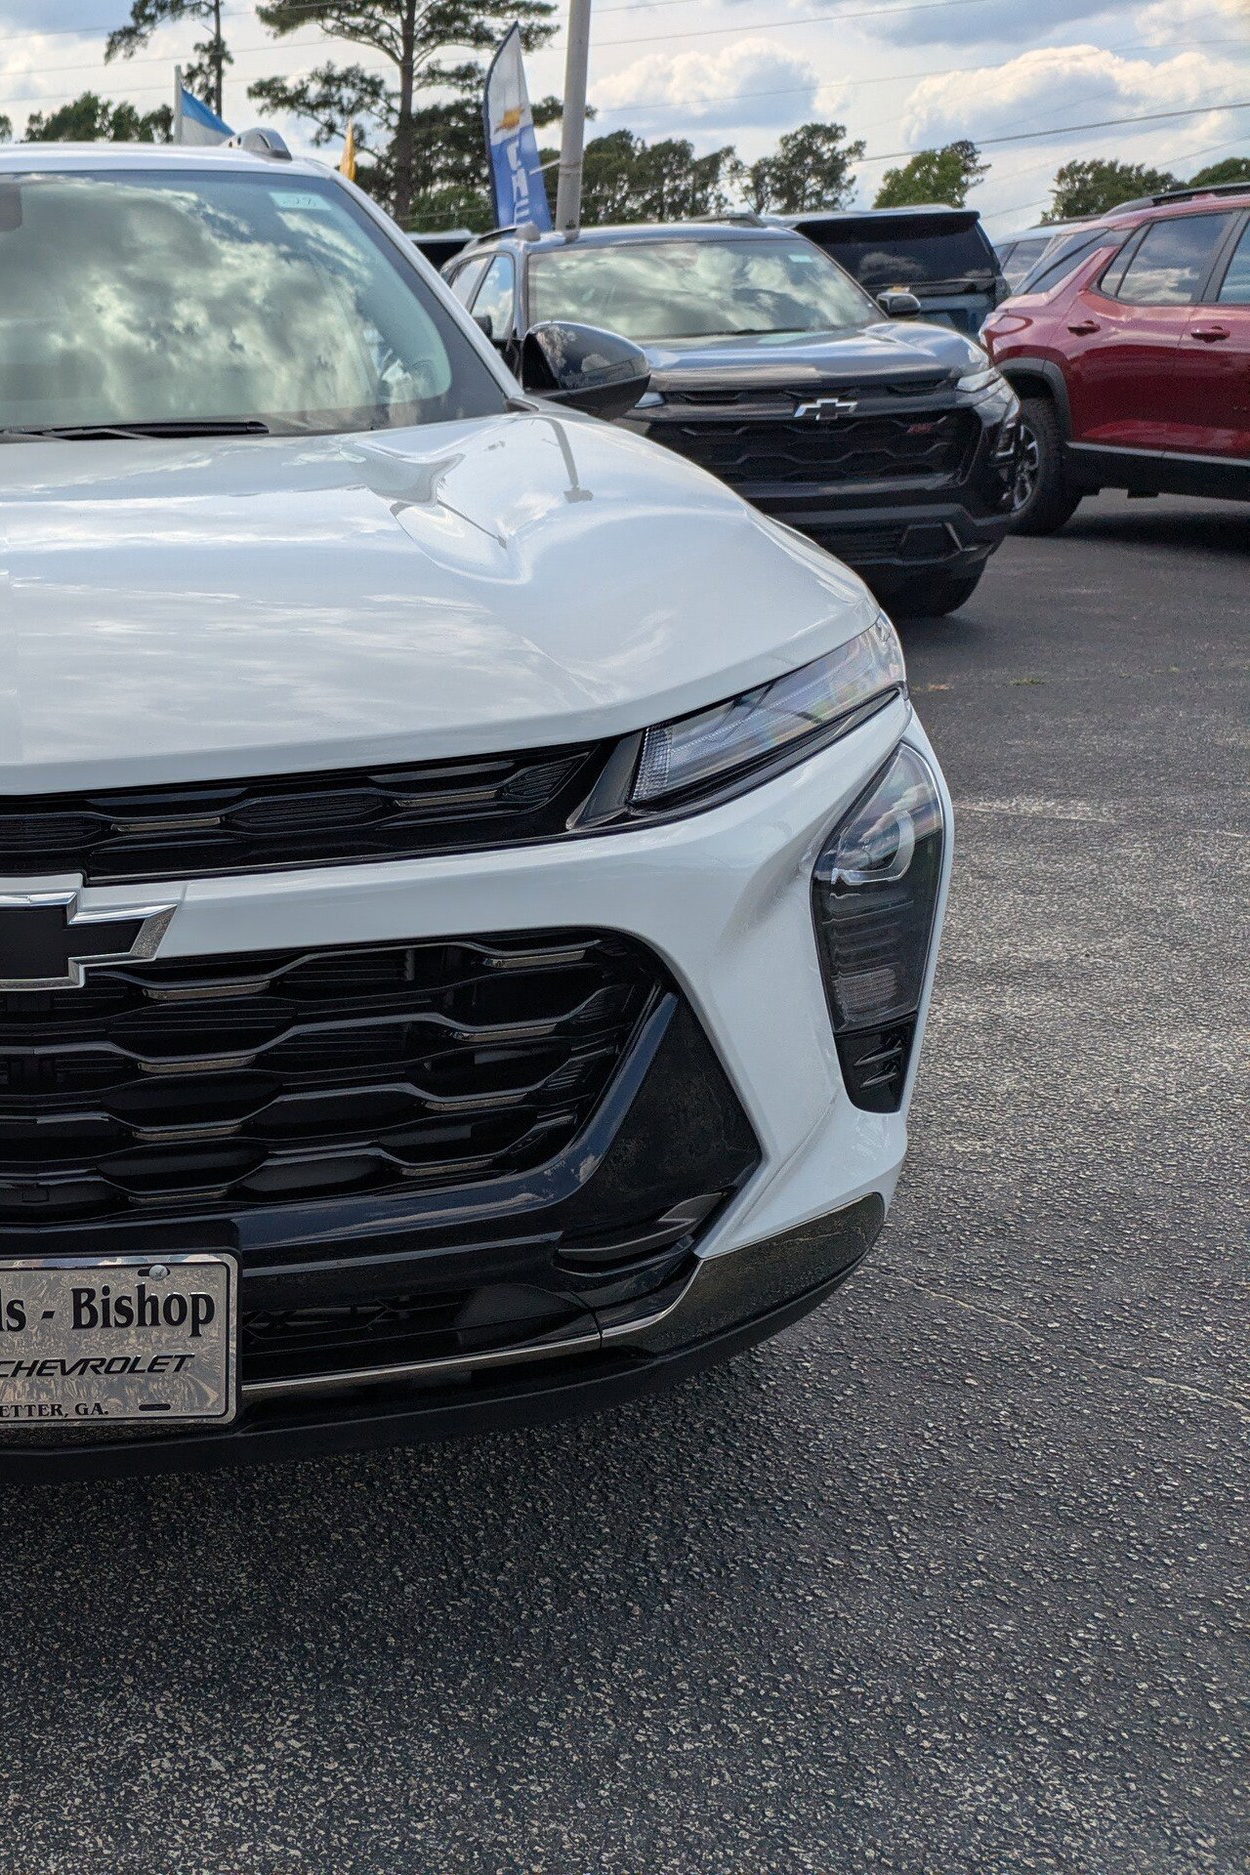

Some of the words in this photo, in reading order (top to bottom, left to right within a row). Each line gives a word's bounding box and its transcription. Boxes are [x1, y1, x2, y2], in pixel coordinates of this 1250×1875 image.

[41, 1310, 55, 1320] -
[71, 1283, 215, 1338] Bishop
[74, 1402, 110, 1417] GA.
